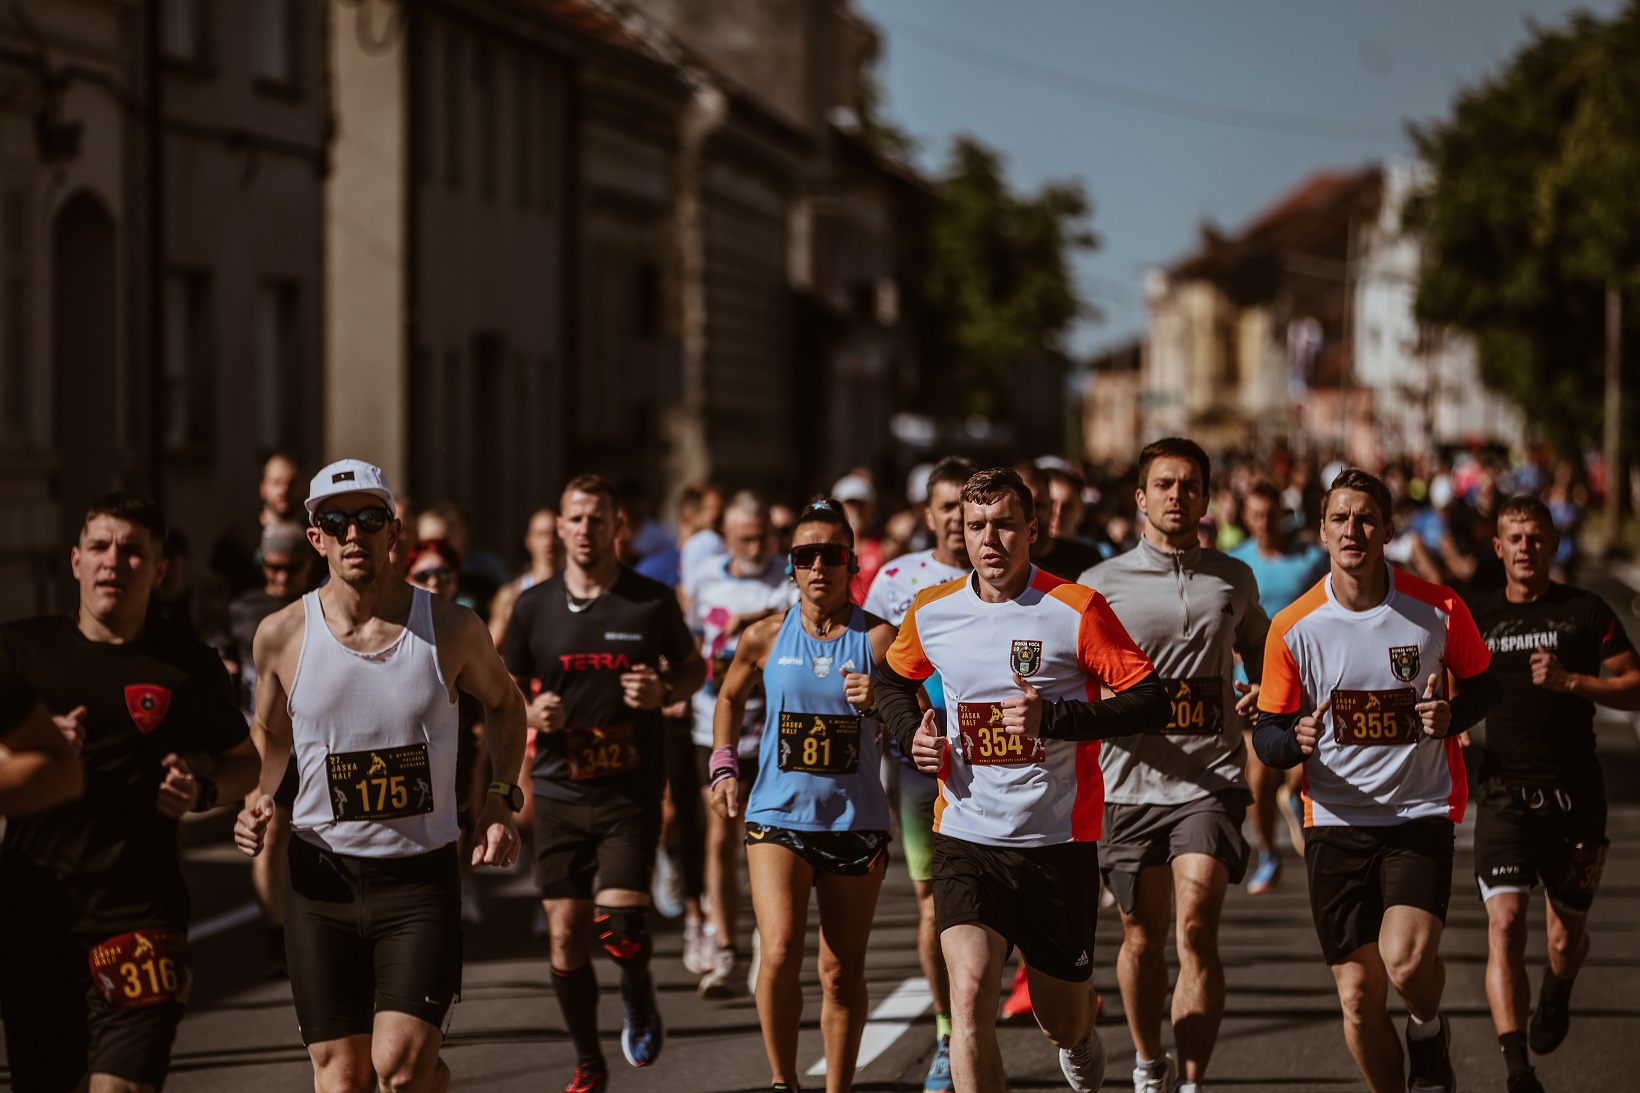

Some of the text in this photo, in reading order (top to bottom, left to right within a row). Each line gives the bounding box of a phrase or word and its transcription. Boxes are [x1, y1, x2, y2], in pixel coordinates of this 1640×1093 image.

[1500, 630, 1558, 652] SPARTAN
[558, 652, 630, 671] TERRA
[1352, 712, 1398, 739] 355
[803, 737, 831, 766] 81
[978, 727, 1024, 757] 354
[331, 763, 358, 773] JASKA
[582, 744, 622, 772] 342
[332, 772, 352, 781] HALF
[356, 775, 408, 812] 175
[120, 958, 178, 998] 316
